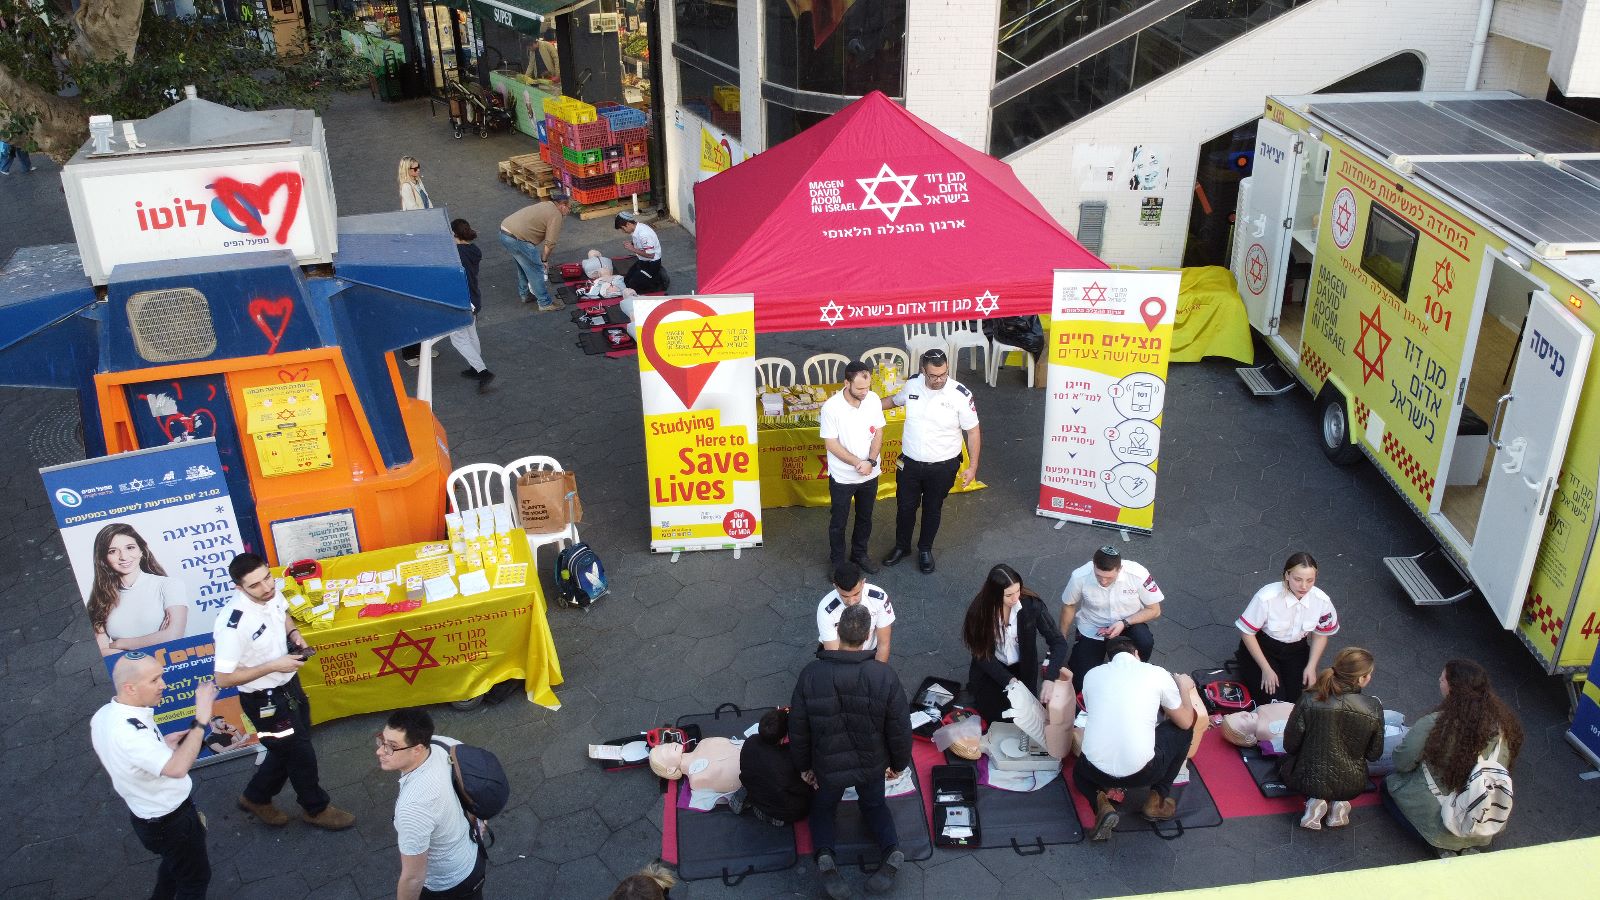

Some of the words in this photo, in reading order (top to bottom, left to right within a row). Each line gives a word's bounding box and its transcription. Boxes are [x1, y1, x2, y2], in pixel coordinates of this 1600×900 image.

[494, 8, 513, 27] SUPER
[1260, 141, 1284, 164] יציאה
[924, 172, 943, 183] דוד
[947, 172, 966, 183] מגן
[1341, 160, 1376, 190] מיוחדות
[809, 180, 844, 190] MAGEN
[939, 182, 968, 193] אדום
[809, 188, 840, 198] DAVID
[923, 193, 970, 206] בישראל
[811, 196, 842, 205] ADOM
[811, 205, 822, 213] IN
[825, 202, 857, 213] ISRAEL
[1378, 184, 1424, 221] למשימות
[822, 226, 872, 239] הלאומי
[877, 222, 925, 236] ההצלה
[930, 219, 966, 233] ארגון
[1427, 215, 1468, 251] היחידה
[223, 239, 244, 248] הפיס
[245, 237, 269, 246] מפעל
[1340, 256, 1367, 285] הלאומי
[1319, 264, 1347, 299] MAGEN
[1316, 280, 1340, 310] DAVID
[1370, 280, 1401, 311] ההצלה
[847, 304, 893, 318] בישראל
[897, 302, 926, 314] אדום
[930, 300, 948, 313] דוד
[953, 298, 972, 313] מגן
[1314, 297, 1338, 328] ADOM
[1424, 295, 1452, 332] 101
[1404, 308, 1429, 336] ארגון
[1059, 332, 1094, 345] חיים
[1311, 312, 1319, 329] IN
[1321, 322, 1346, 356] ISRAEL
[1102, 333, 1162, 350] מצילים
[1058, 348, 1099, 360] צעדים
[1103, 350, 1159, 364] בשלושה
[1404, 336, 1423, 369] דוד
[1530, 328, 1565, 378] כניסה
[1424, 357, 1447, 390] מגן
[1065, 381, 1091, 391] חייגו
[1114, 387, 1119, 395] 1
[1410, 374, 1442, 418] אדום
[1390, 379, 1435, 444] בישראל
[651, 415, 714, 435] Studying
[1061, 424, 1087, 434] בצעו
[696, 434, 726, 447] Here
[730, 434, 744, 446] to
[1051, 435, 1068, 443] חזה
[1109, 430, 1115, 438] 2
[1071, 437, 1095, 446] עיסויי
[678, 447, 749, 475] Save
[884, 451, 897, 459] מגן
[1045, 466, 1069, 474] מפעם
[1073, 467, 1096, 478] חברו
[1104, 472, 1111, 480] 3
[1569, 472, 1580, 488] דוד
[198, 488, 221, 498] 21.02
[655, 475, 725, 503] Lives
[1581, 484, 1593, 501] מגן
[145, 495, 183, 509] המודעות
[184, 493, 196, 502] יום
[1573, 491, 1591, 512] אדום
[109, 503, 142, 515] לשימוש
[1560, 491, 1587, 524] בישראל
[65, 510, 107, 524] במפעמים
[730, 518, 749, 529] 101
[163, 519, 229, 542] המציגה
[193, 534, 233, 551] אינה
[181, 549, 237, 569] רופאה
[203, 565, 230, 580] בל
[200, 579, 237, 597] כולה
[468, 610, 507, 624] ההצלה
[443, 632, 462, 643] דוד
[467, 628, 486, 640] מגן
[316, 639, 352, 652] tional
[355, 633, 380, 644] EMS
[458, 639, 488, 652] אדום
[320, 652, 357, 665] MAGEN
[443, 651, 488, 666] בישראל
[322, 660, 354, 672] DAVID
[324, 667, 356, 680] ADOM
[341, 672, 373, 684] ISRAEL
